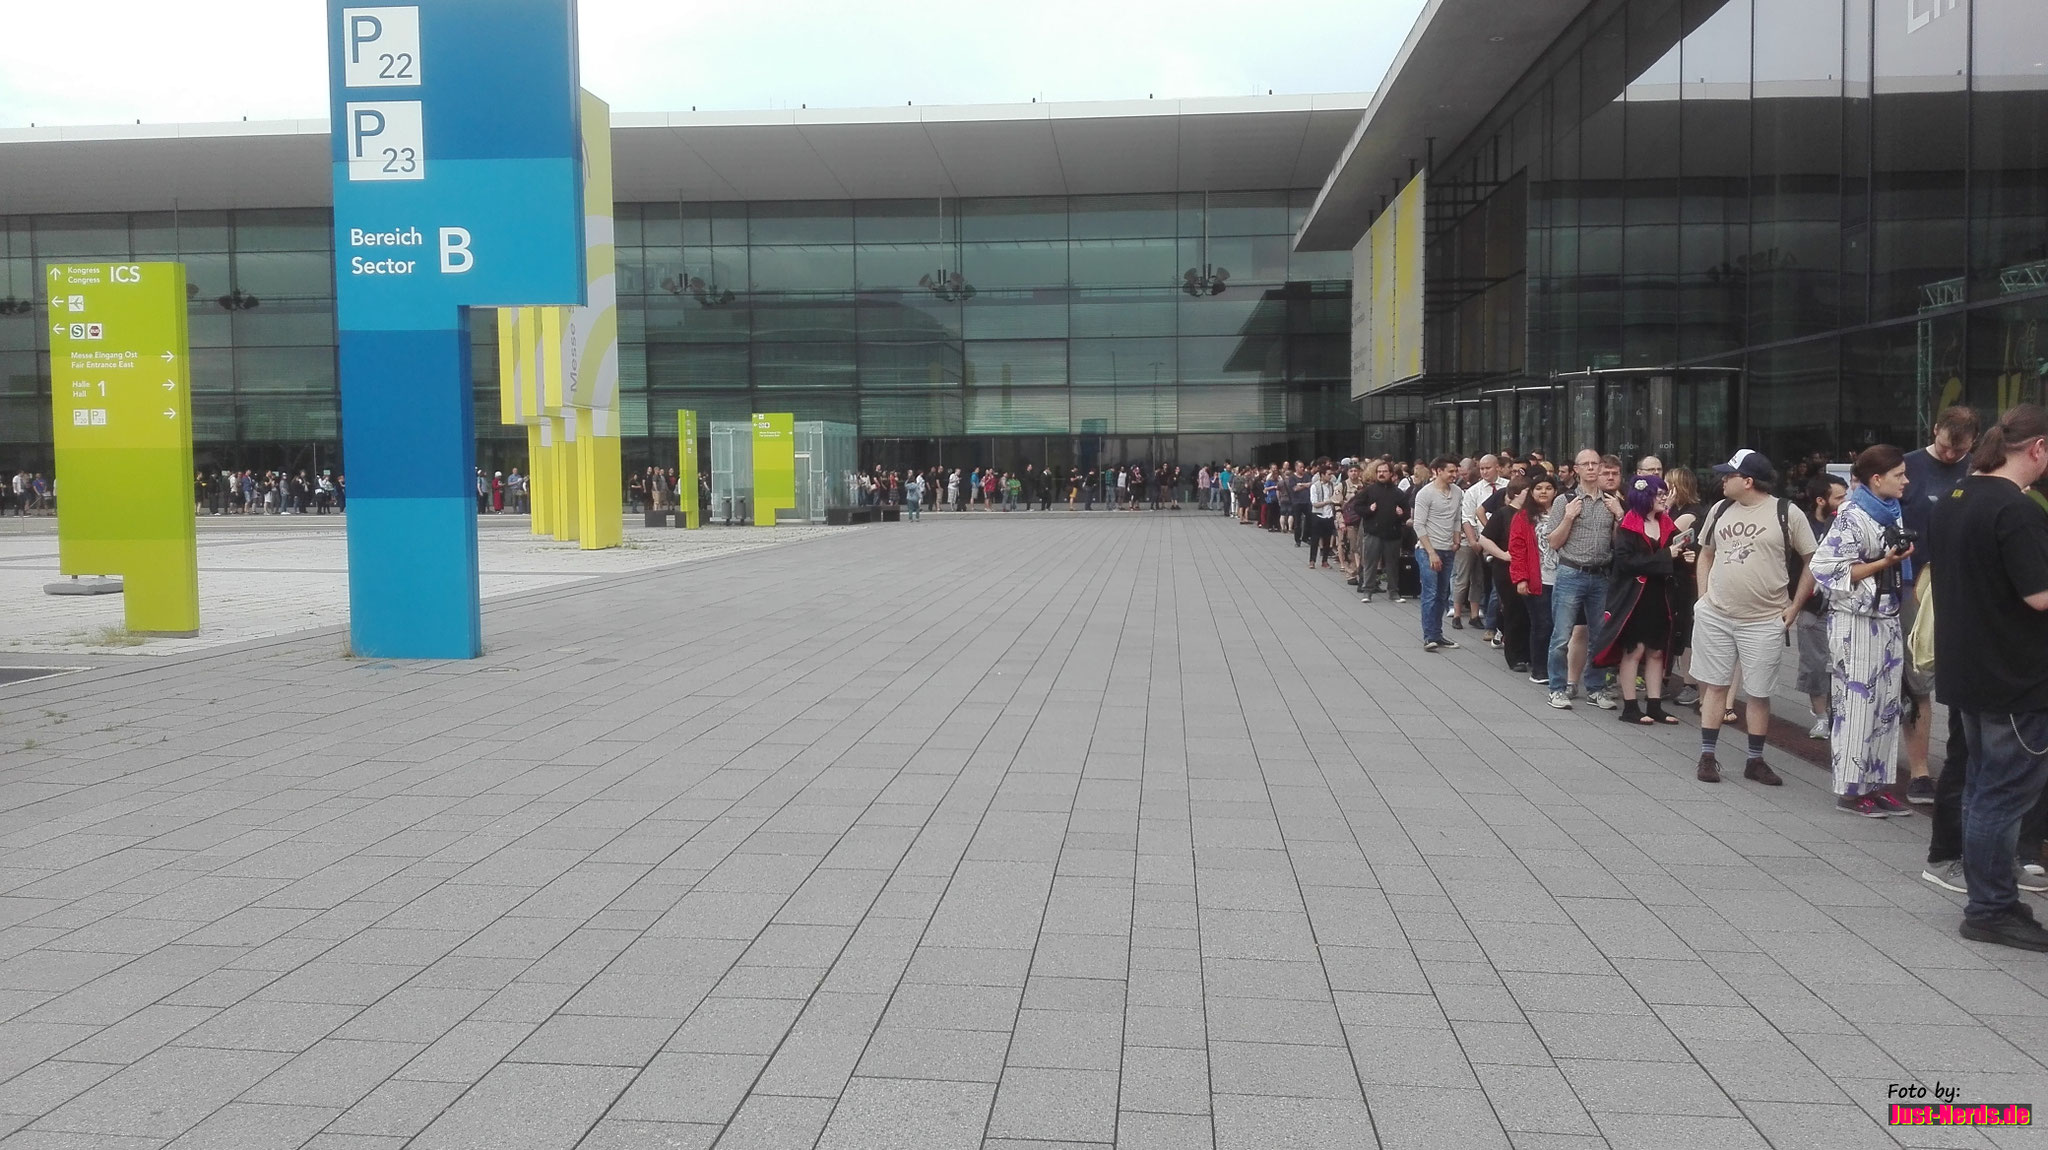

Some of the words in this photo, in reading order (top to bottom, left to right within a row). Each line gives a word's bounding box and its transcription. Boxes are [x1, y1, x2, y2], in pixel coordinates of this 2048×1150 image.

[351, 15, 383, 63] P
[378, 53, 413, 79] 22
[354, 109, 386, 158] P
[382, 147, 416, 173] 23
[350, 226, 423, 246] Bereich
[439, 226, 474, 274] B
[67, 266, 100, 276] Kongress
[110, 265, 141, 283] ICS
[351, 256, 416, 275] Sector
[67, 276, 100, 285] Congress
[95, 351, 123, 360] Eingang
[124, 350, 138, 358] Ost
[71, 361, 85, 369] Fair
[118, 360, 134, 368] East
[97, 380, 105, 397] 1
[1719, 521, 1767, 541] WOO!
